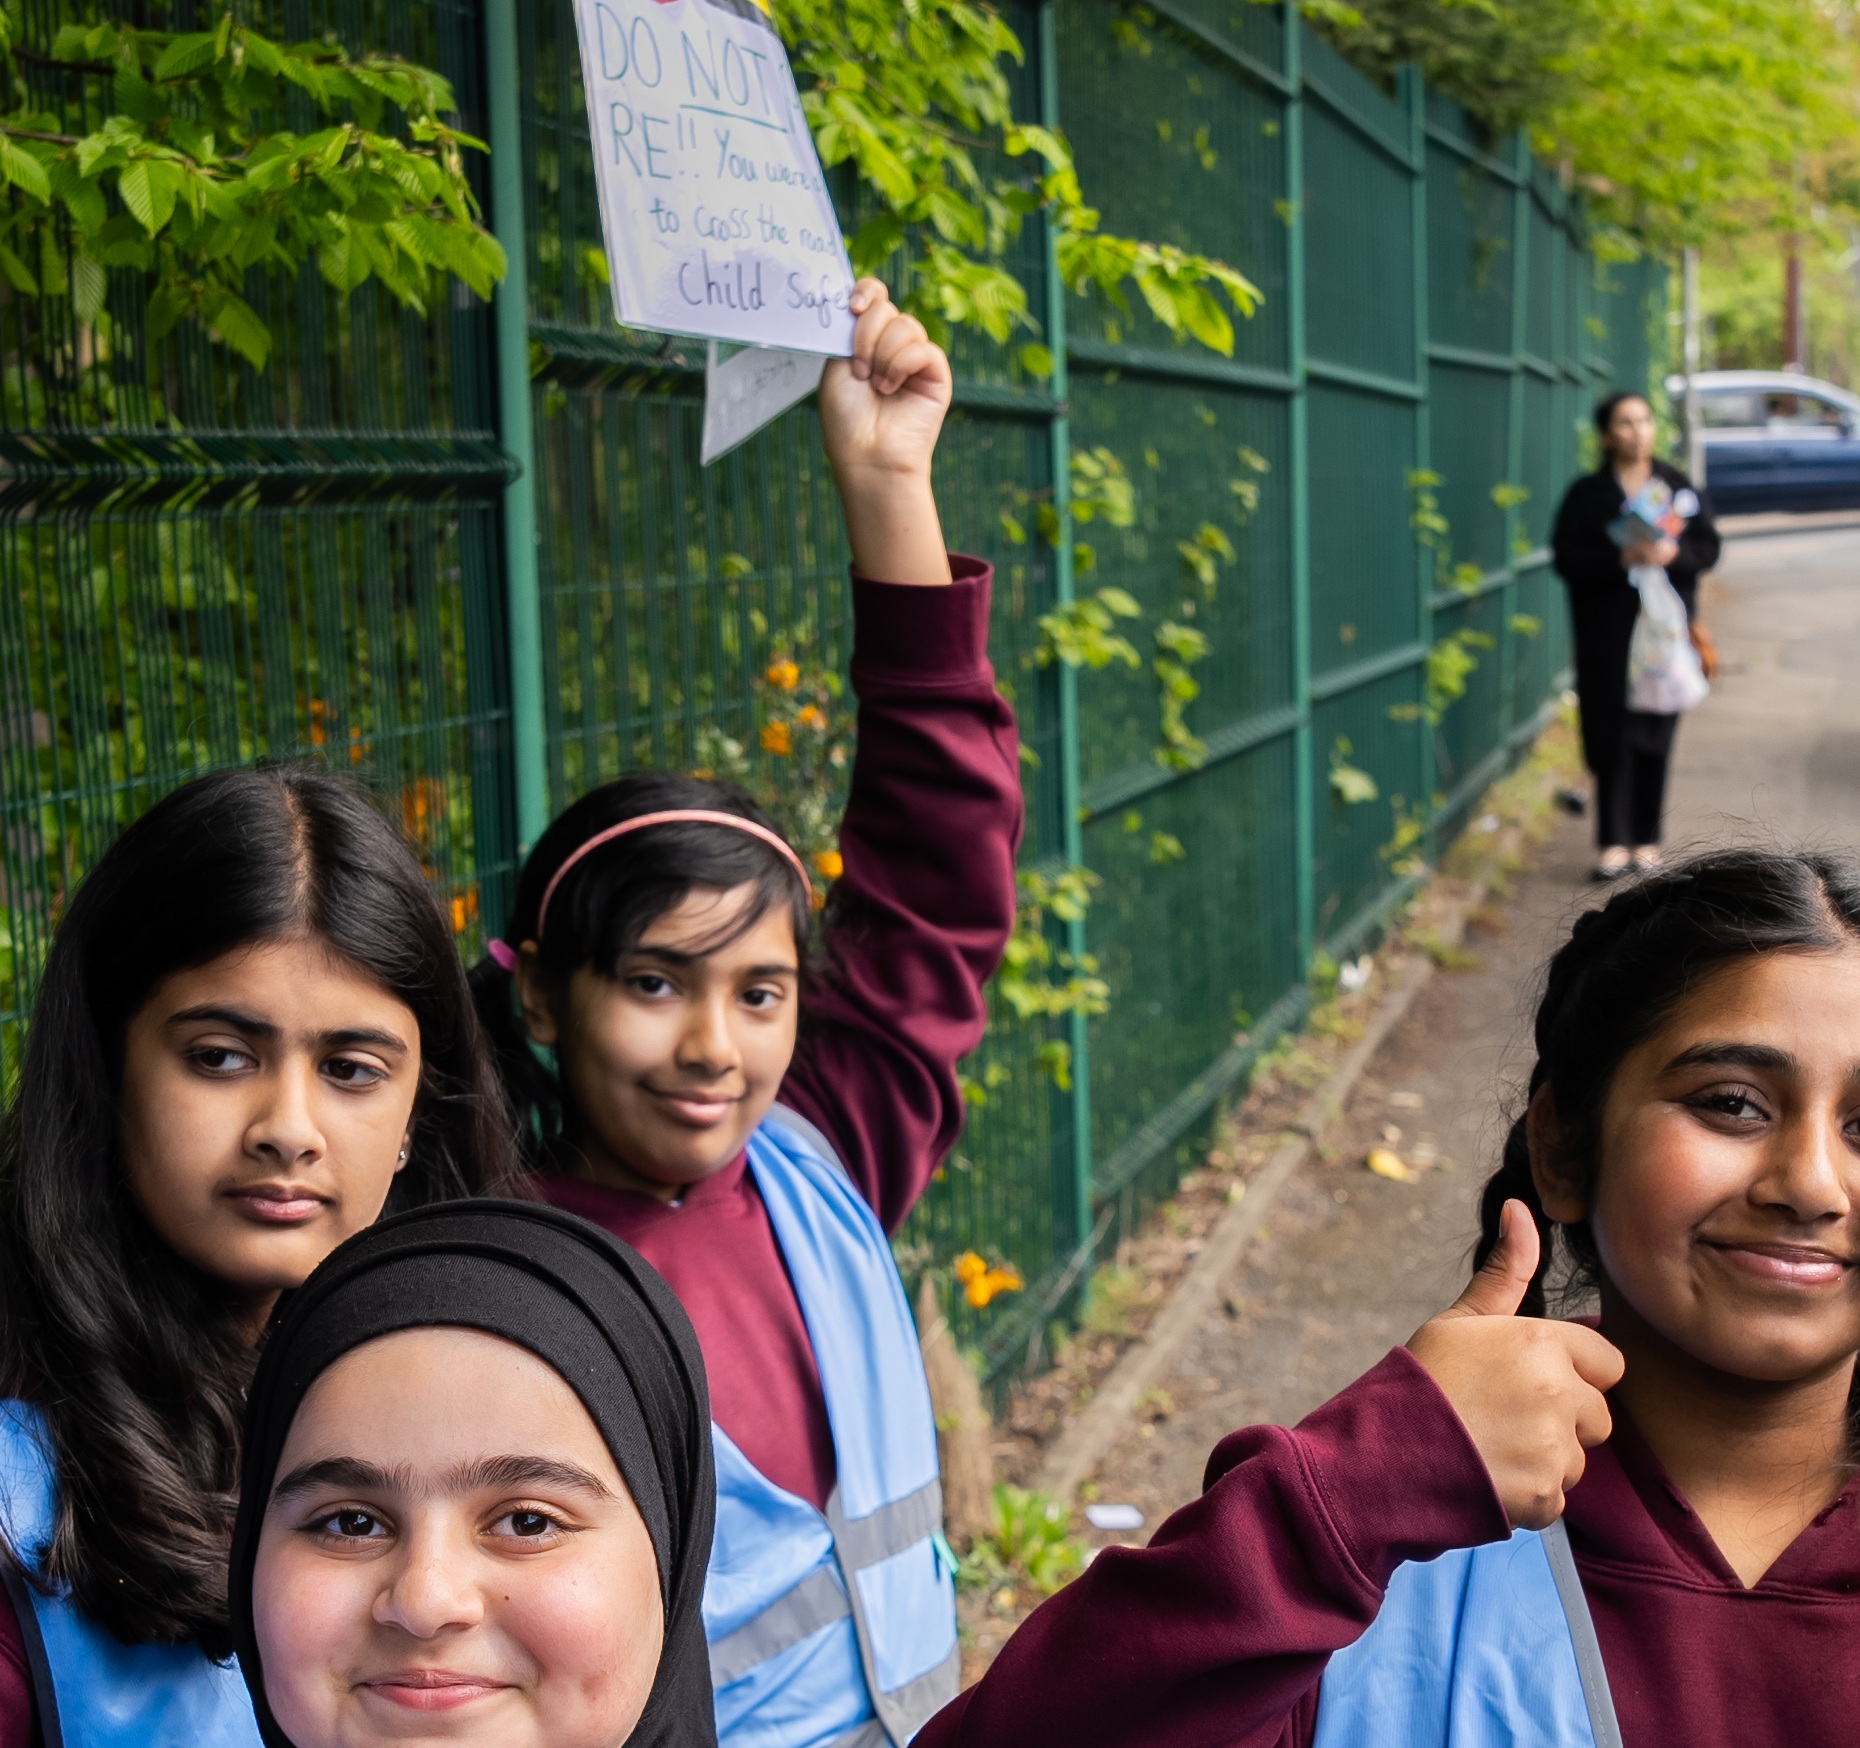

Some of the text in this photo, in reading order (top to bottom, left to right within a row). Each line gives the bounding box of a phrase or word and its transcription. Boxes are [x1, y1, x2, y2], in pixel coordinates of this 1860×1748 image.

[595, 3, 663, 89] DO
[680, 29, 768, 117] NOT
[714, 128, 757, 182] You
[649, 197, 680, 234] to
[756, 202, 790, 246] the
[678, 248, 767, 312] Child
